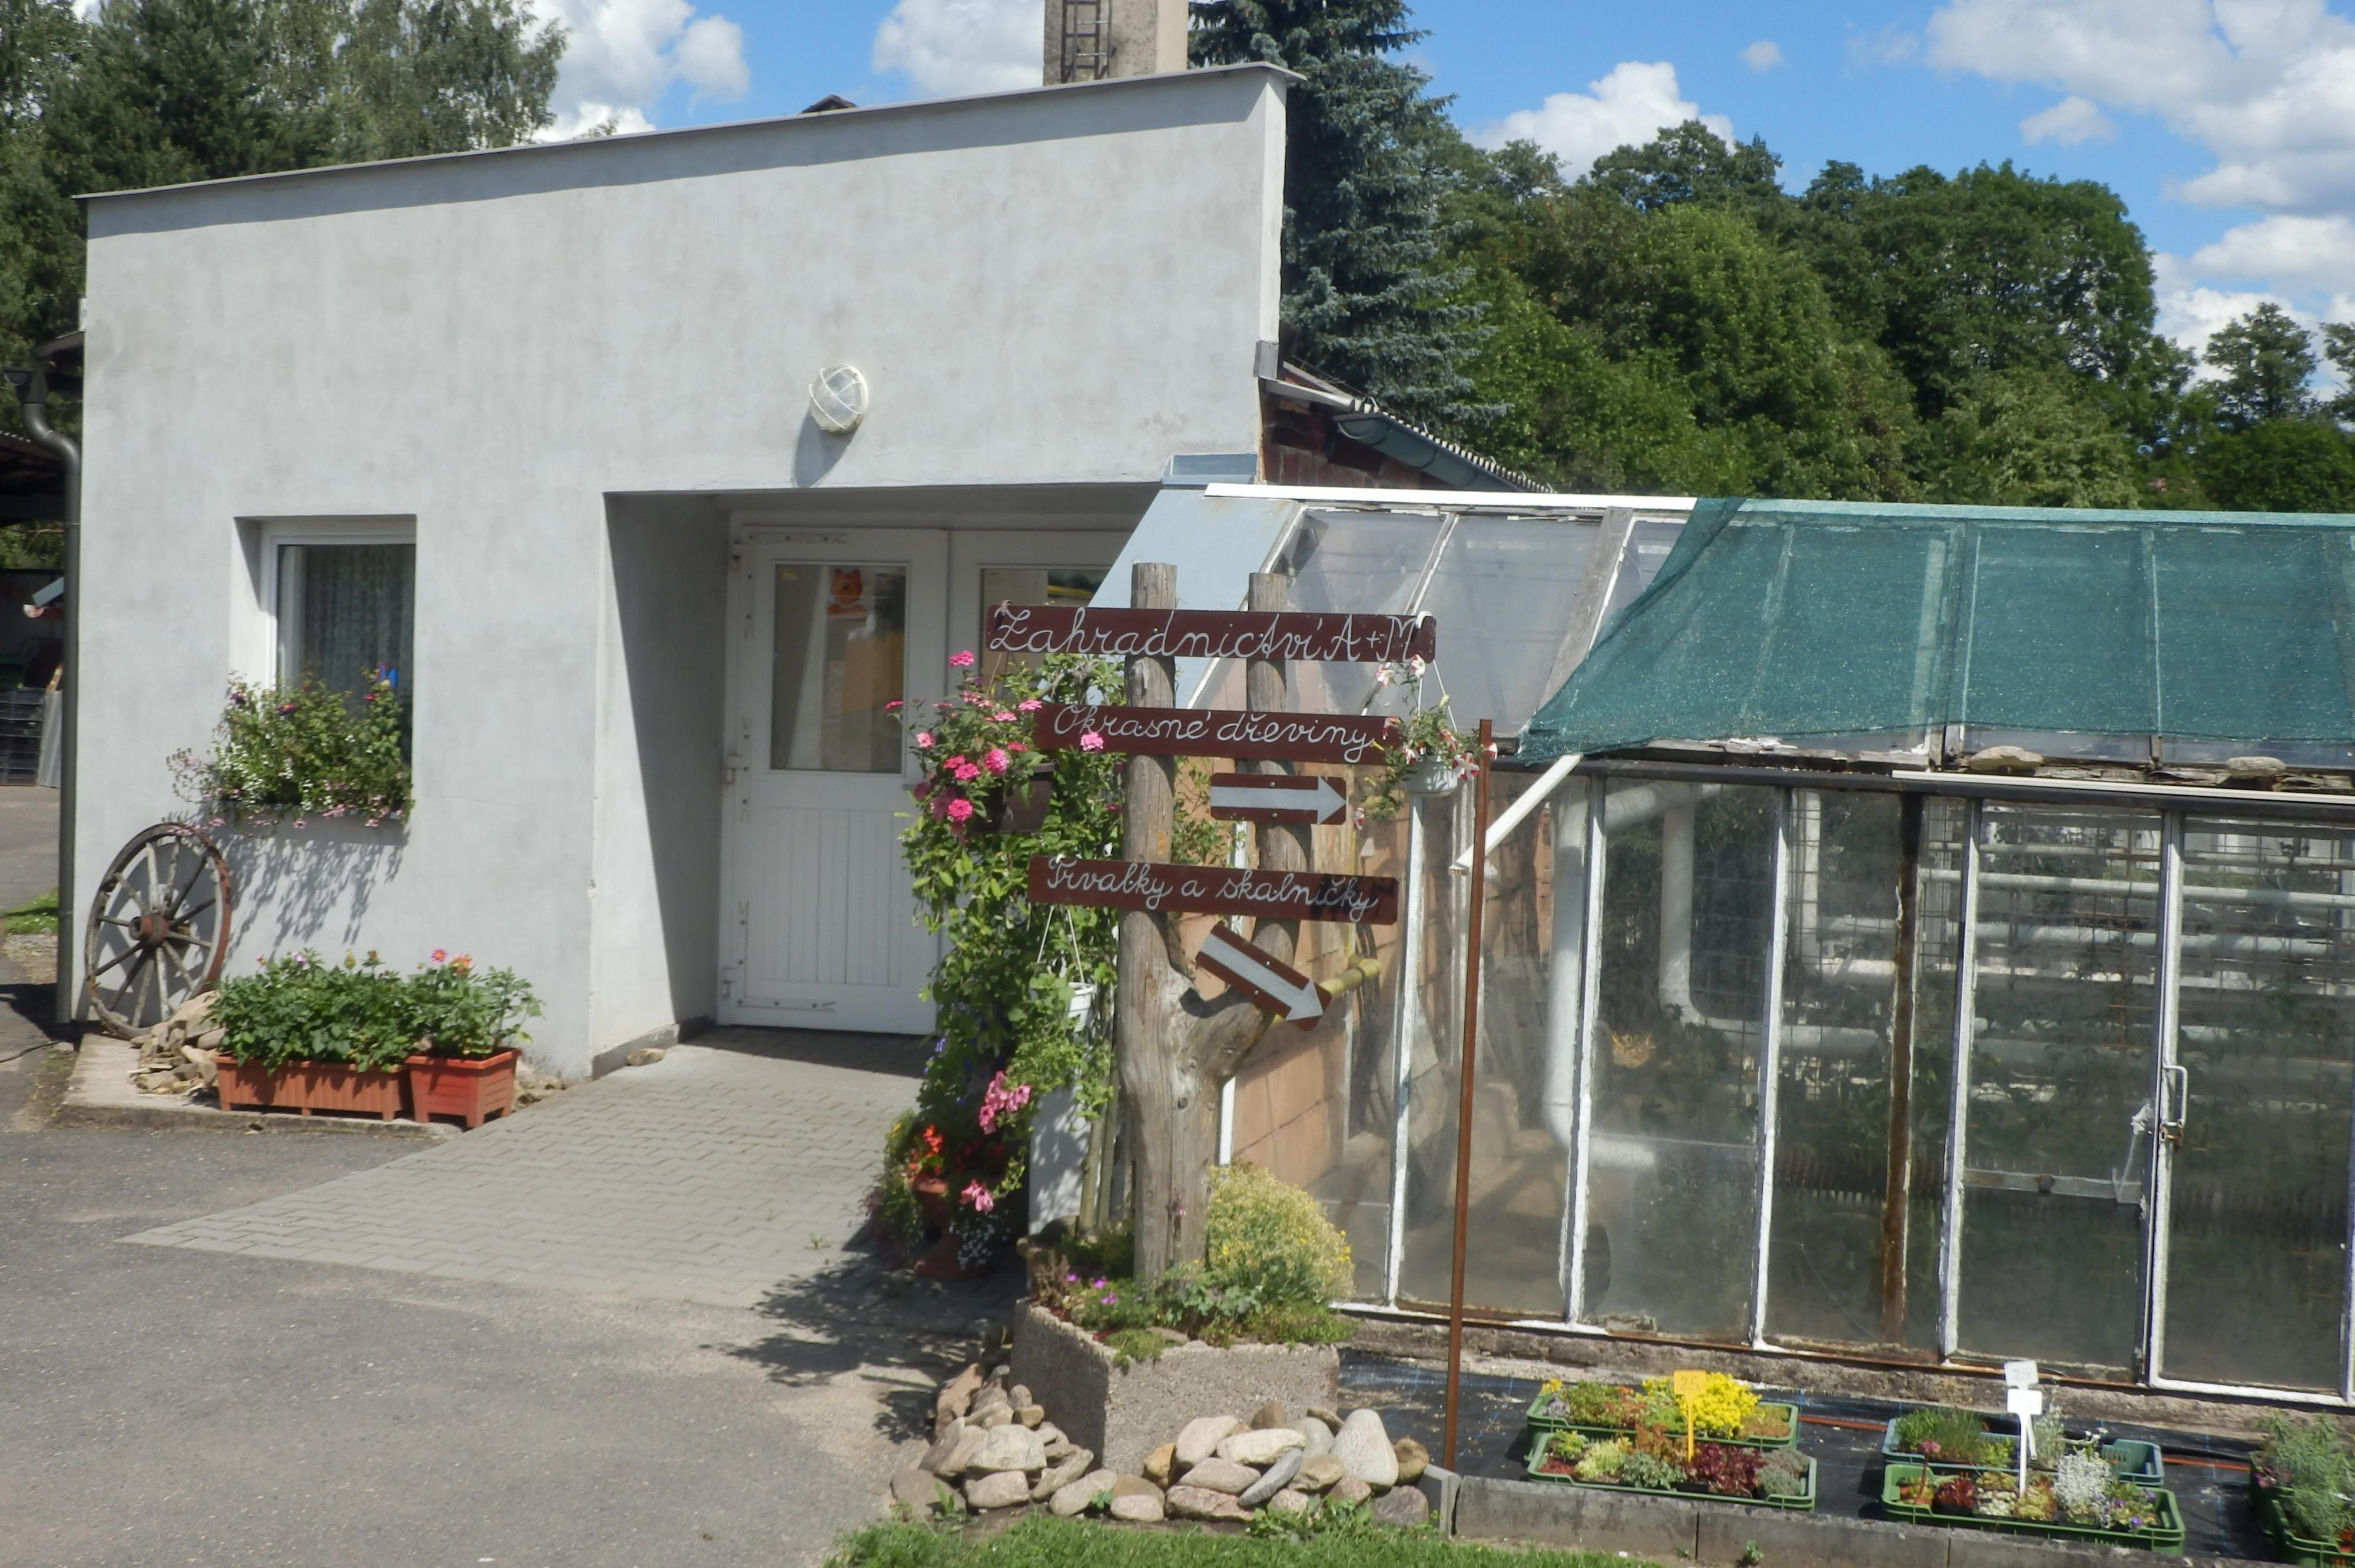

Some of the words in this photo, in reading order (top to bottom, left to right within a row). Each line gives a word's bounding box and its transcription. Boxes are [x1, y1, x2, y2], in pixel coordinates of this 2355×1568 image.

[990, 606, 1322, 660] Zahradnictví
[1054, 705, 1212, 739] Okrasné
[1216, 713, 1375, 763] dřeviny
[1047, 856, 1173, 910] Trvalky
[1180, 879, 1206, 898] a
[1215, 869, 1379, 923] skalničky
